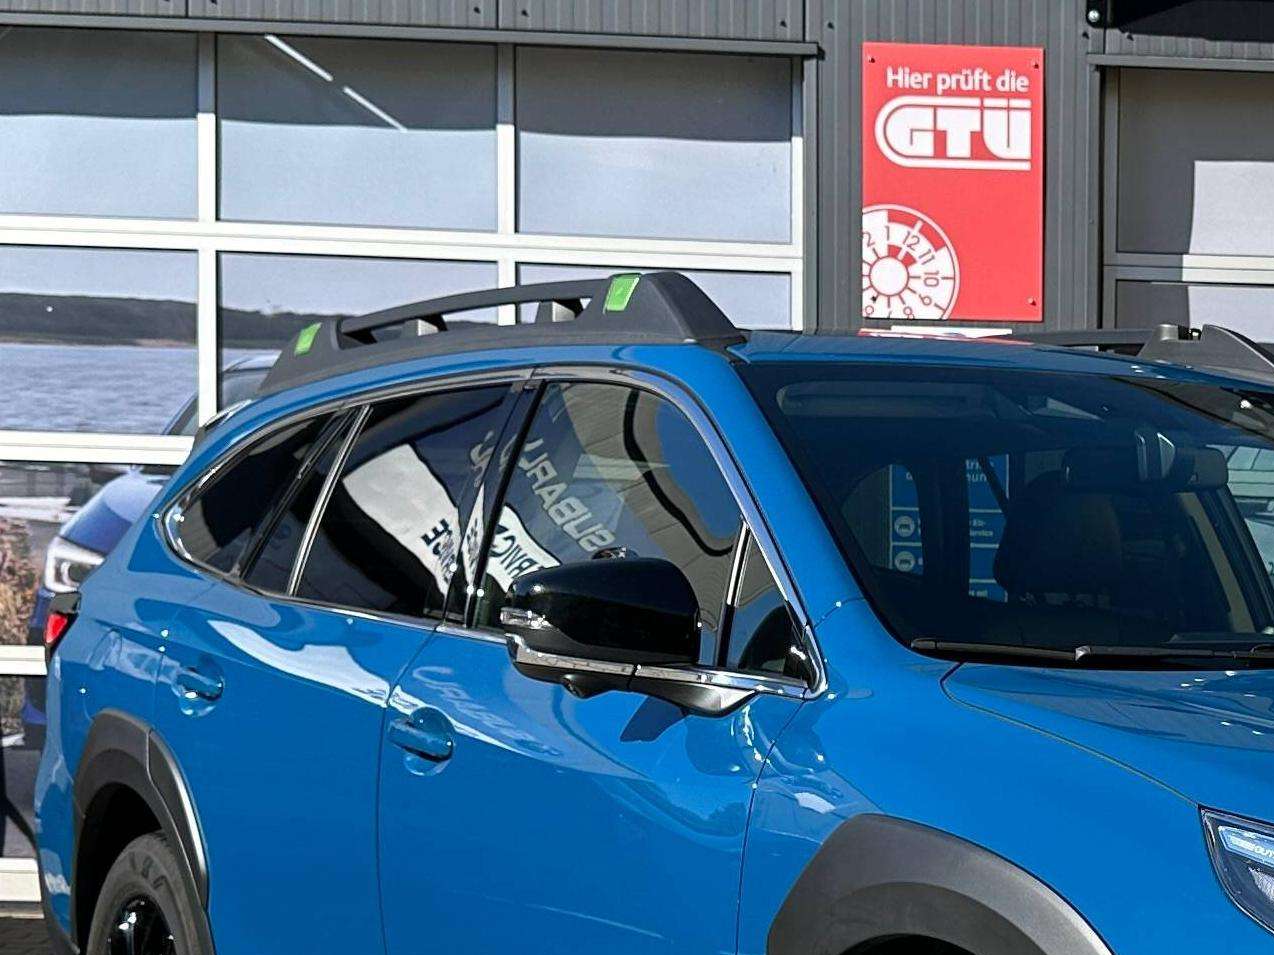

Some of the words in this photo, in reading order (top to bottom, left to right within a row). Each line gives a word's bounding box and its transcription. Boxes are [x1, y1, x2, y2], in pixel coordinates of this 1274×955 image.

[886, 66, 932, 89] Hier
[936, 67, 992, 95] prüft
[996, 69, 1030, 92] die
[884, 97, 1031, 161] GTÜ
[903, 230, 920, 251] 12
[918, 248, 936, 266] 11
[923, 270, 940, 288] 10
